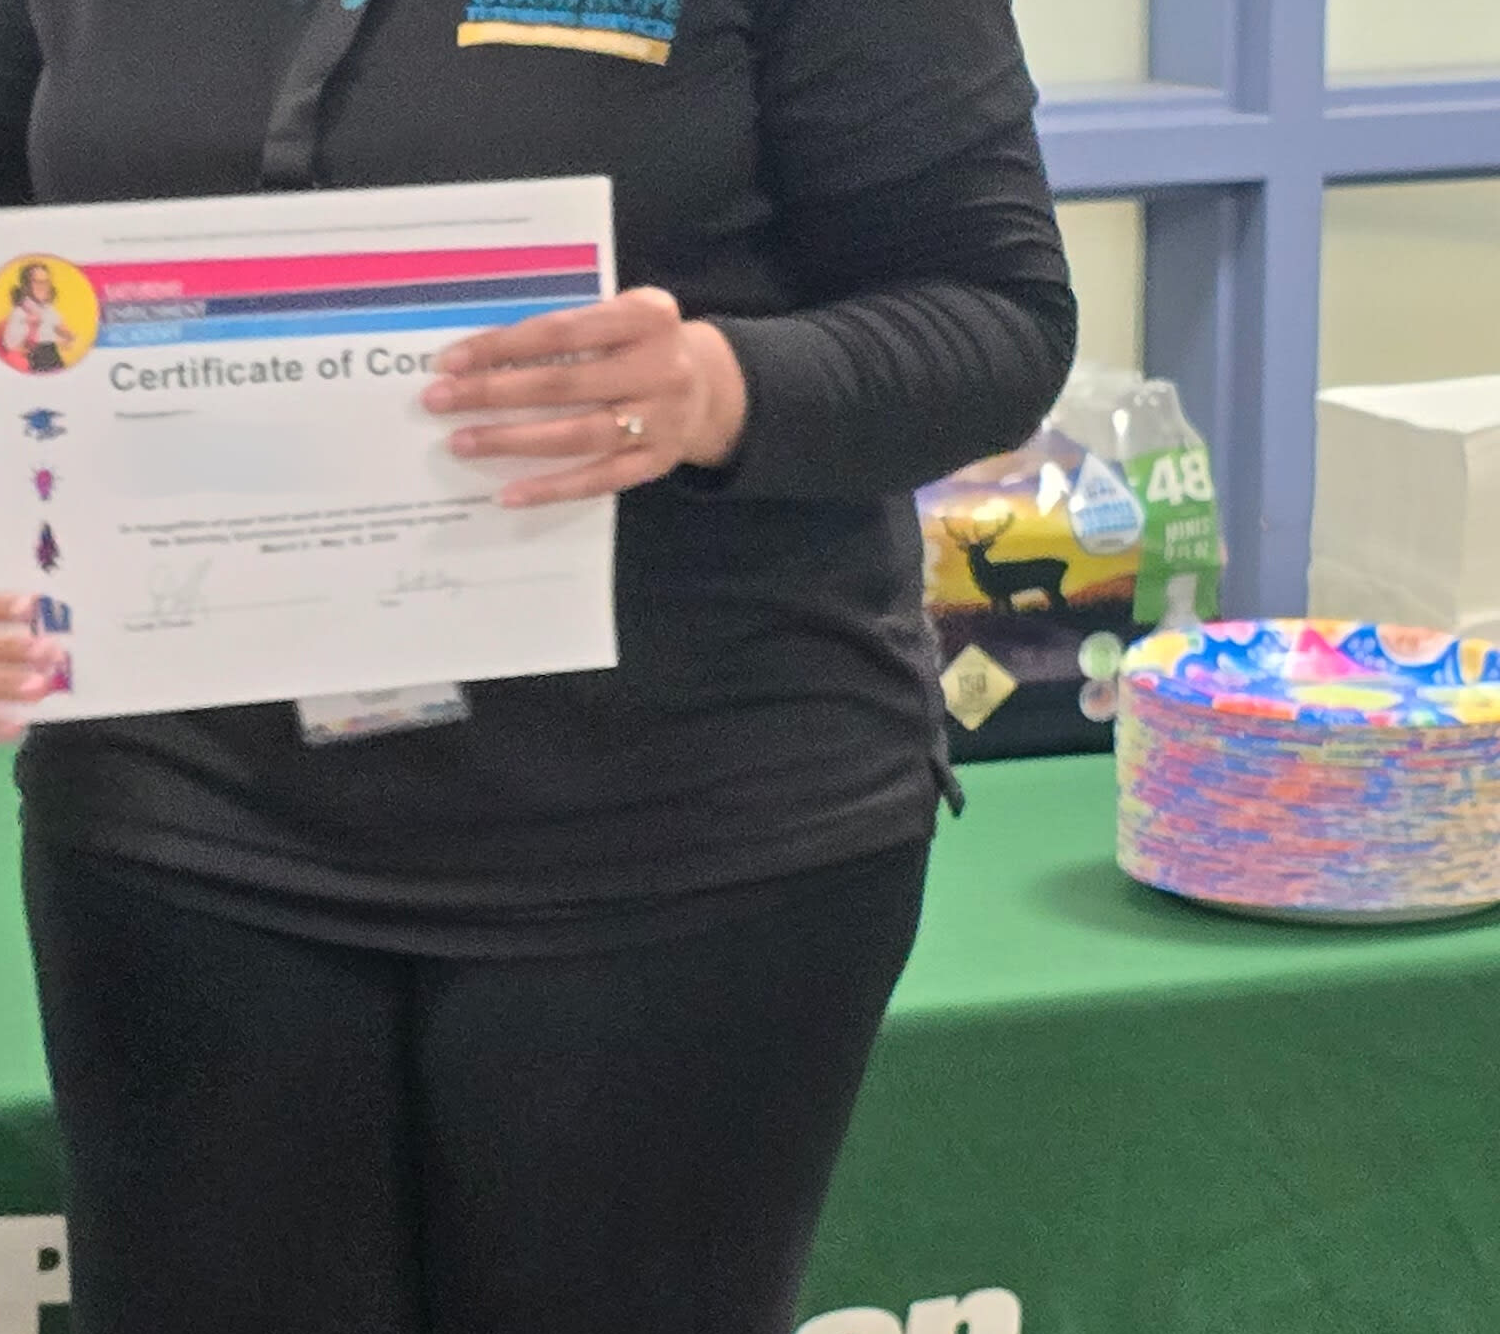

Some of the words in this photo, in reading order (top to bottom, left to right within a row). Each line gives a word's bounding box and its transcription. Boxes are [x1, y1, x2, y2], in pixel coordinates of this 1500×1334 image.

[109, 355, 303, 392] Certificate
[318, 349, 355, 380] of
[1145, 450, 1213, 506] 48
